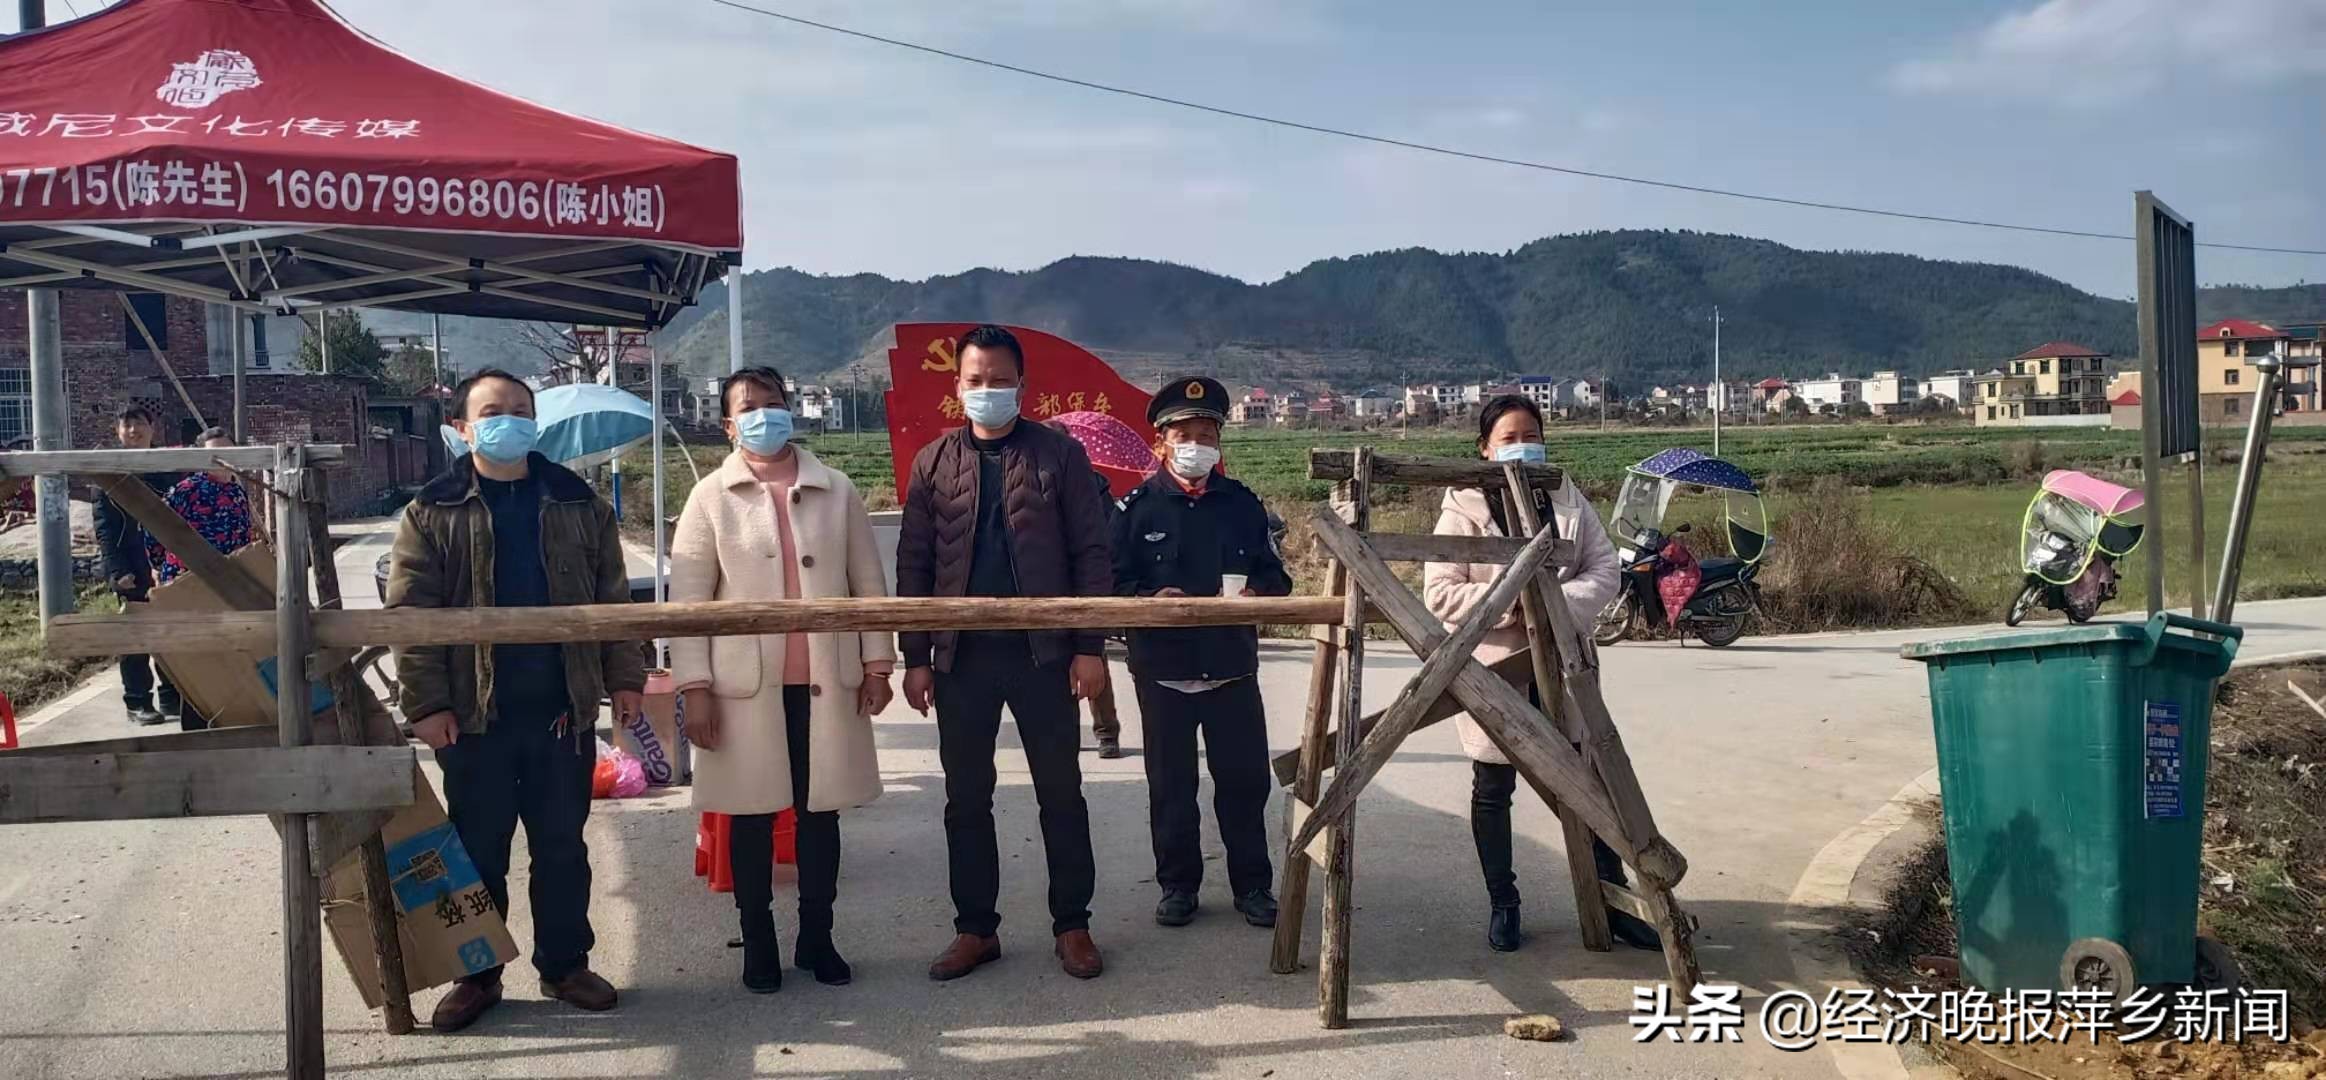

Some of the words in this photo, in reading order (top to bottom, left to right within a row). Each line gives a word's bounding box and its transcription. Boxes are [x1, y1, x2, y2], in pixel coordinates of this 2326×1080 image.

[0, 159, 248, 212] 7715(陈先生)
[266, 167, 666, 231] 16607996806(陈小姐)
